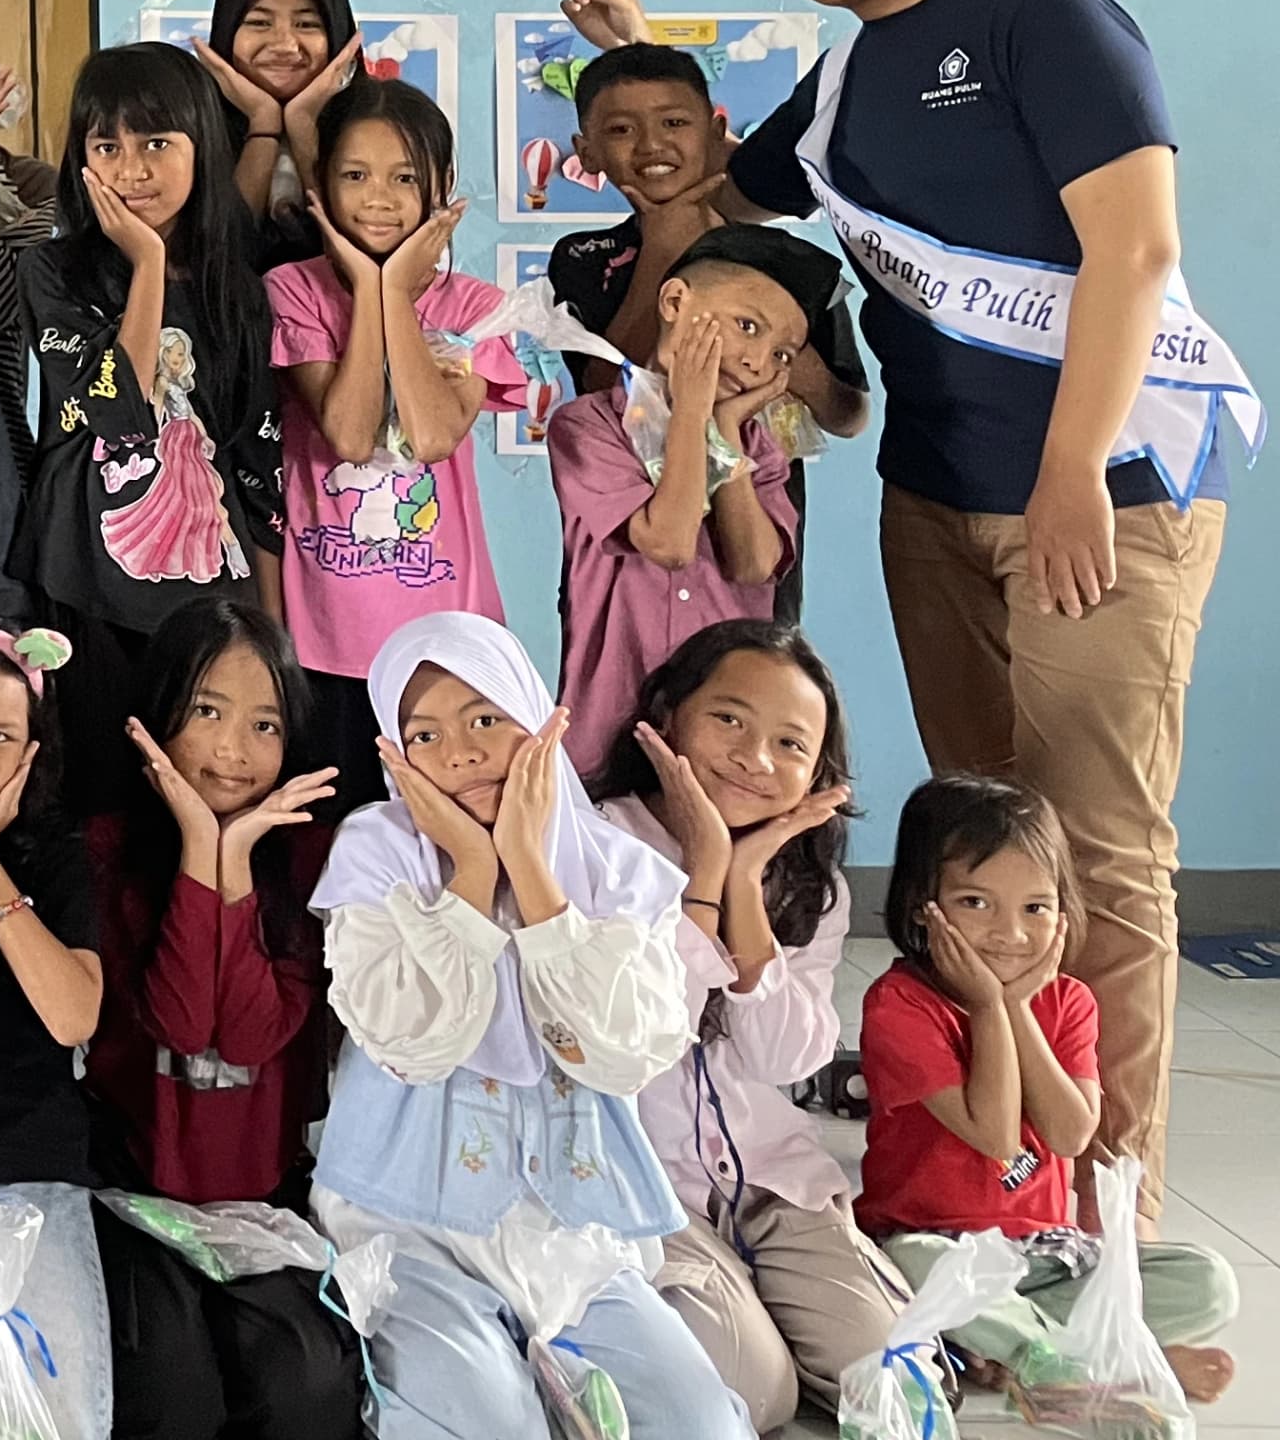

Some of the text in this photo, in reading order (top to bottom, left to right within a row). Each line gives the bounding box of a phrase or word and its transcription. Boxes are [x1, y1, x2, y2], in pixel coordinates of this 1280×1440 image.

[861, 229, 1054, 332] Ruang Pulih
[40, 328, 88, 353] Barbi
